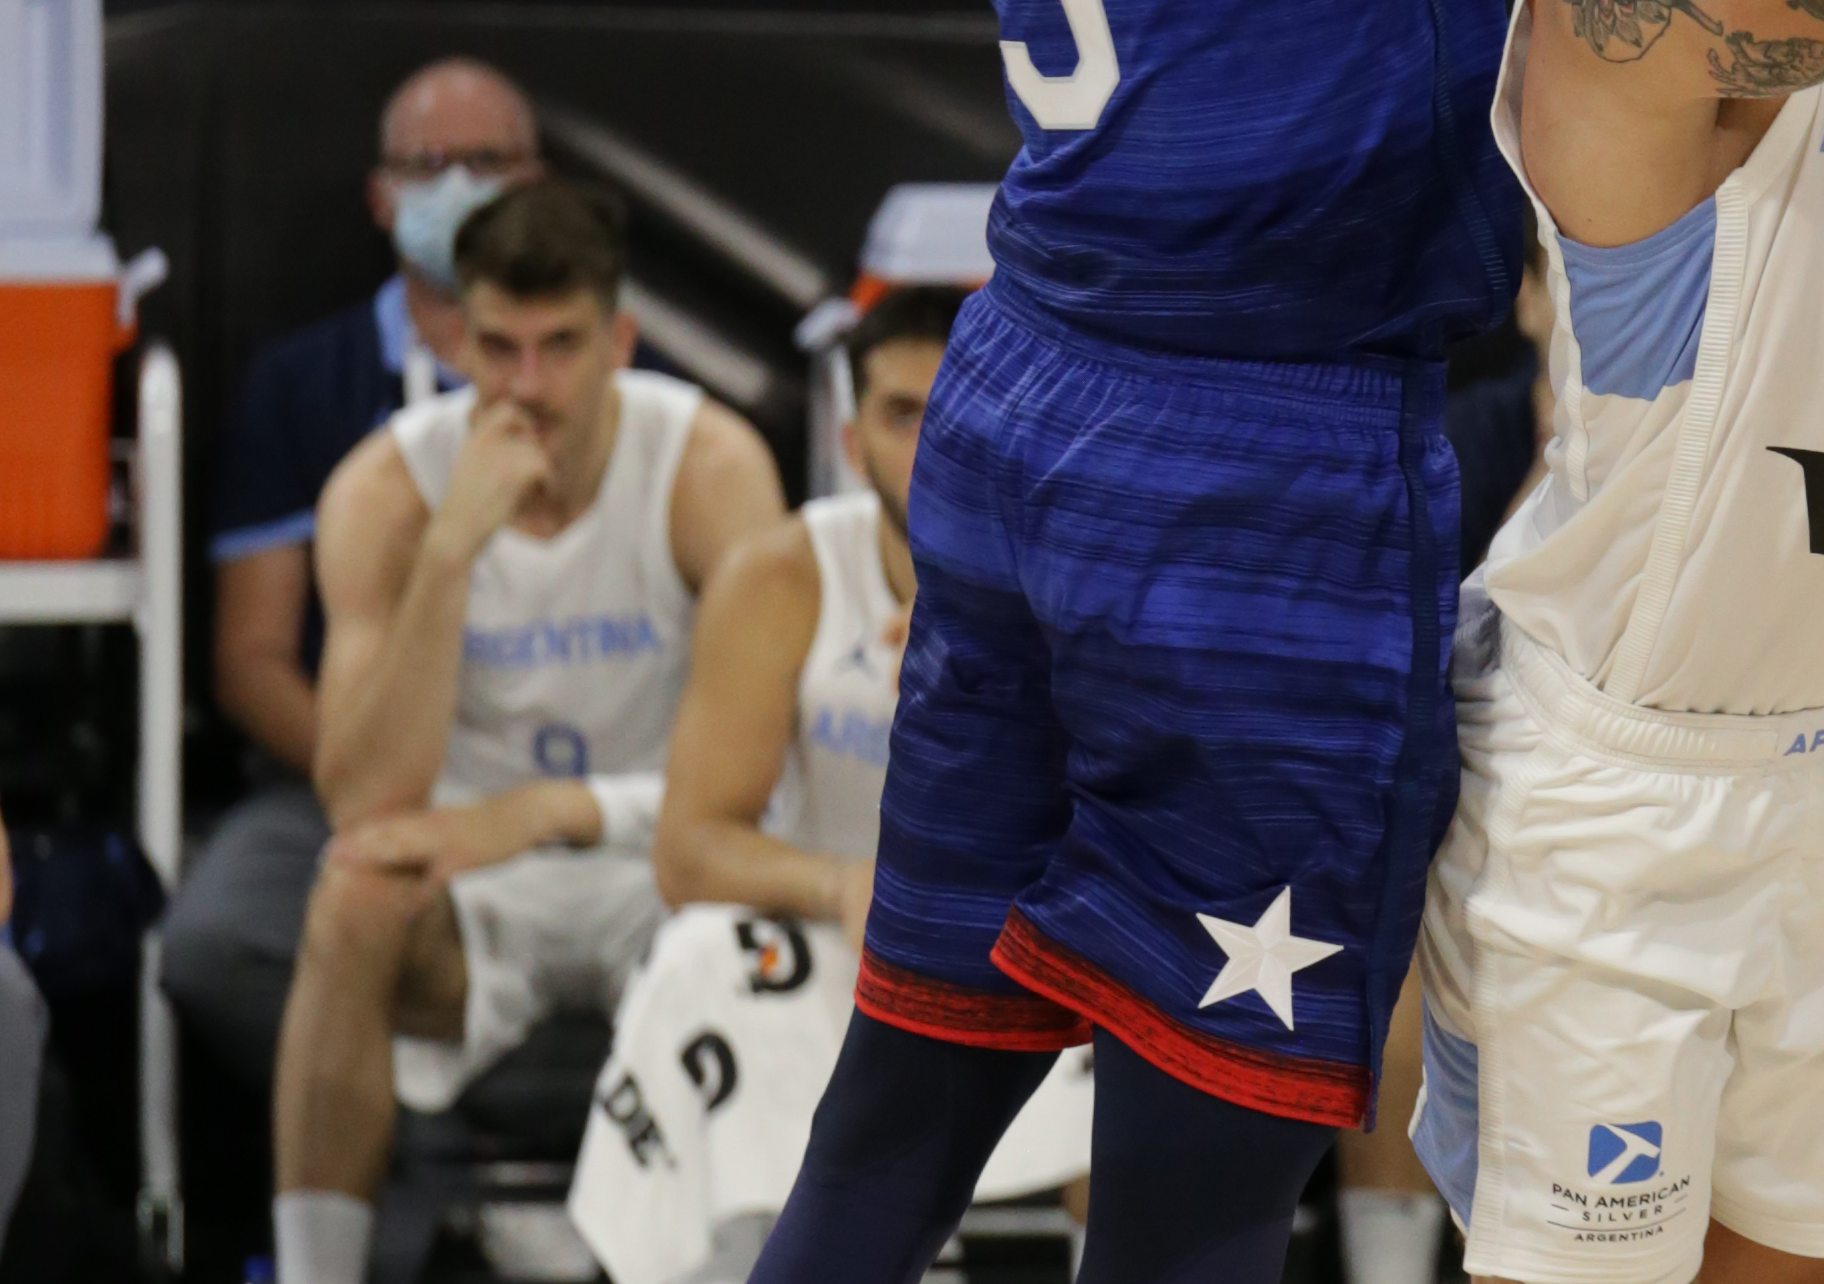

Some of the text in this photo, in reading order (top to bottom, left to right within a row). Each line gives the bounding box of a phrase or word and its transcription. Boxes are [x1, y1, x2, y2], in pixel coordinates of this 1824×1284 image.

[1552, 1175, 1690, 1209] PAN AMERICAN
[1582, 1204, 1663, 1222] SILVER
[1574, 1225, 1664, 1243] ARGENTINA
